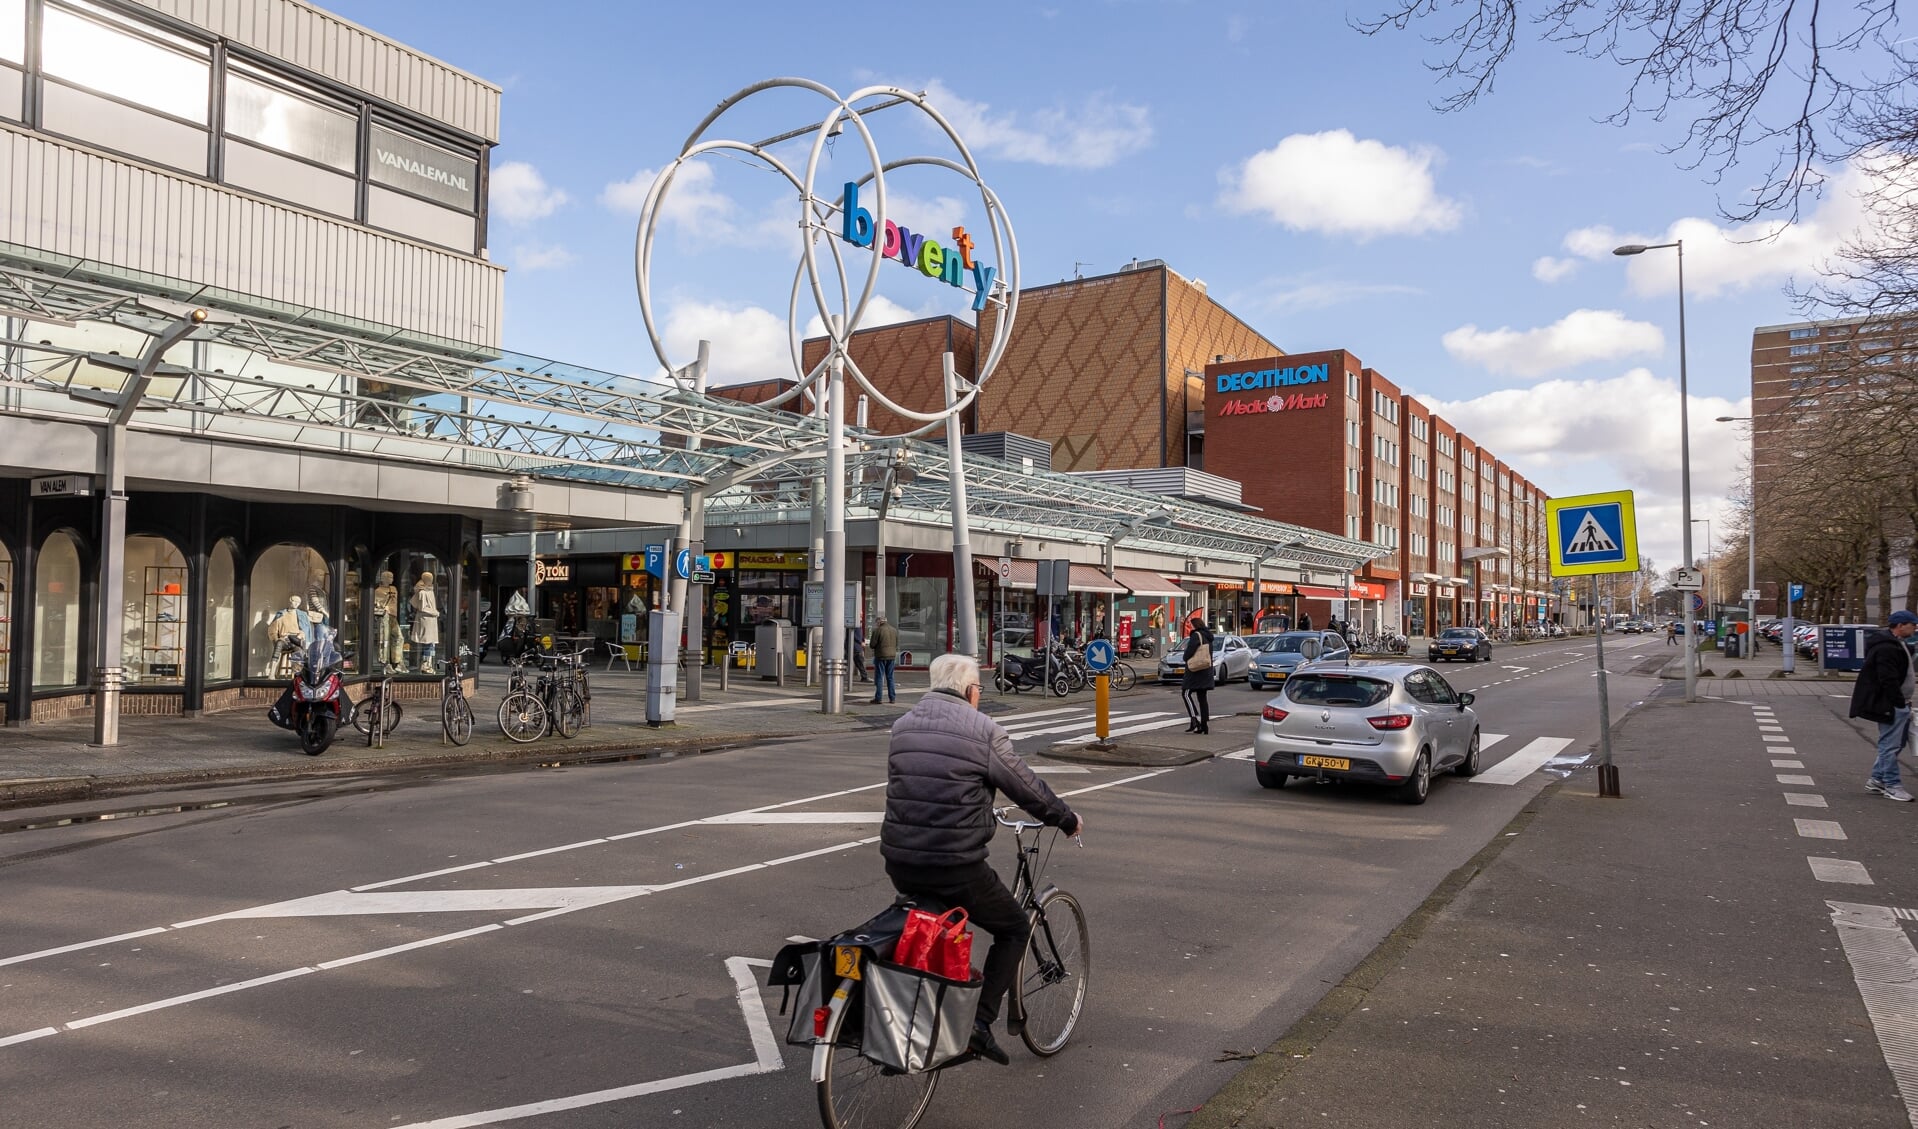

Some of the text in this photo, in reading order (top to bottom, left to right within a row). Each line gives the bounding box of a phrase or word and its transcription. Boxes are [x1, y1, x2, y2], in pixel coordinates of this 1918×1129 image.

[376, 148, 469, 192] VANALEM.NL
[1217, 363, 1329, 393] DECATHLON
[1218, 393, 1328, 417] Media Markt
[649, 554, 658, 567] P
[546, 566, 569, 577] TOKI
[1678, 571, 1693, 582] P5
